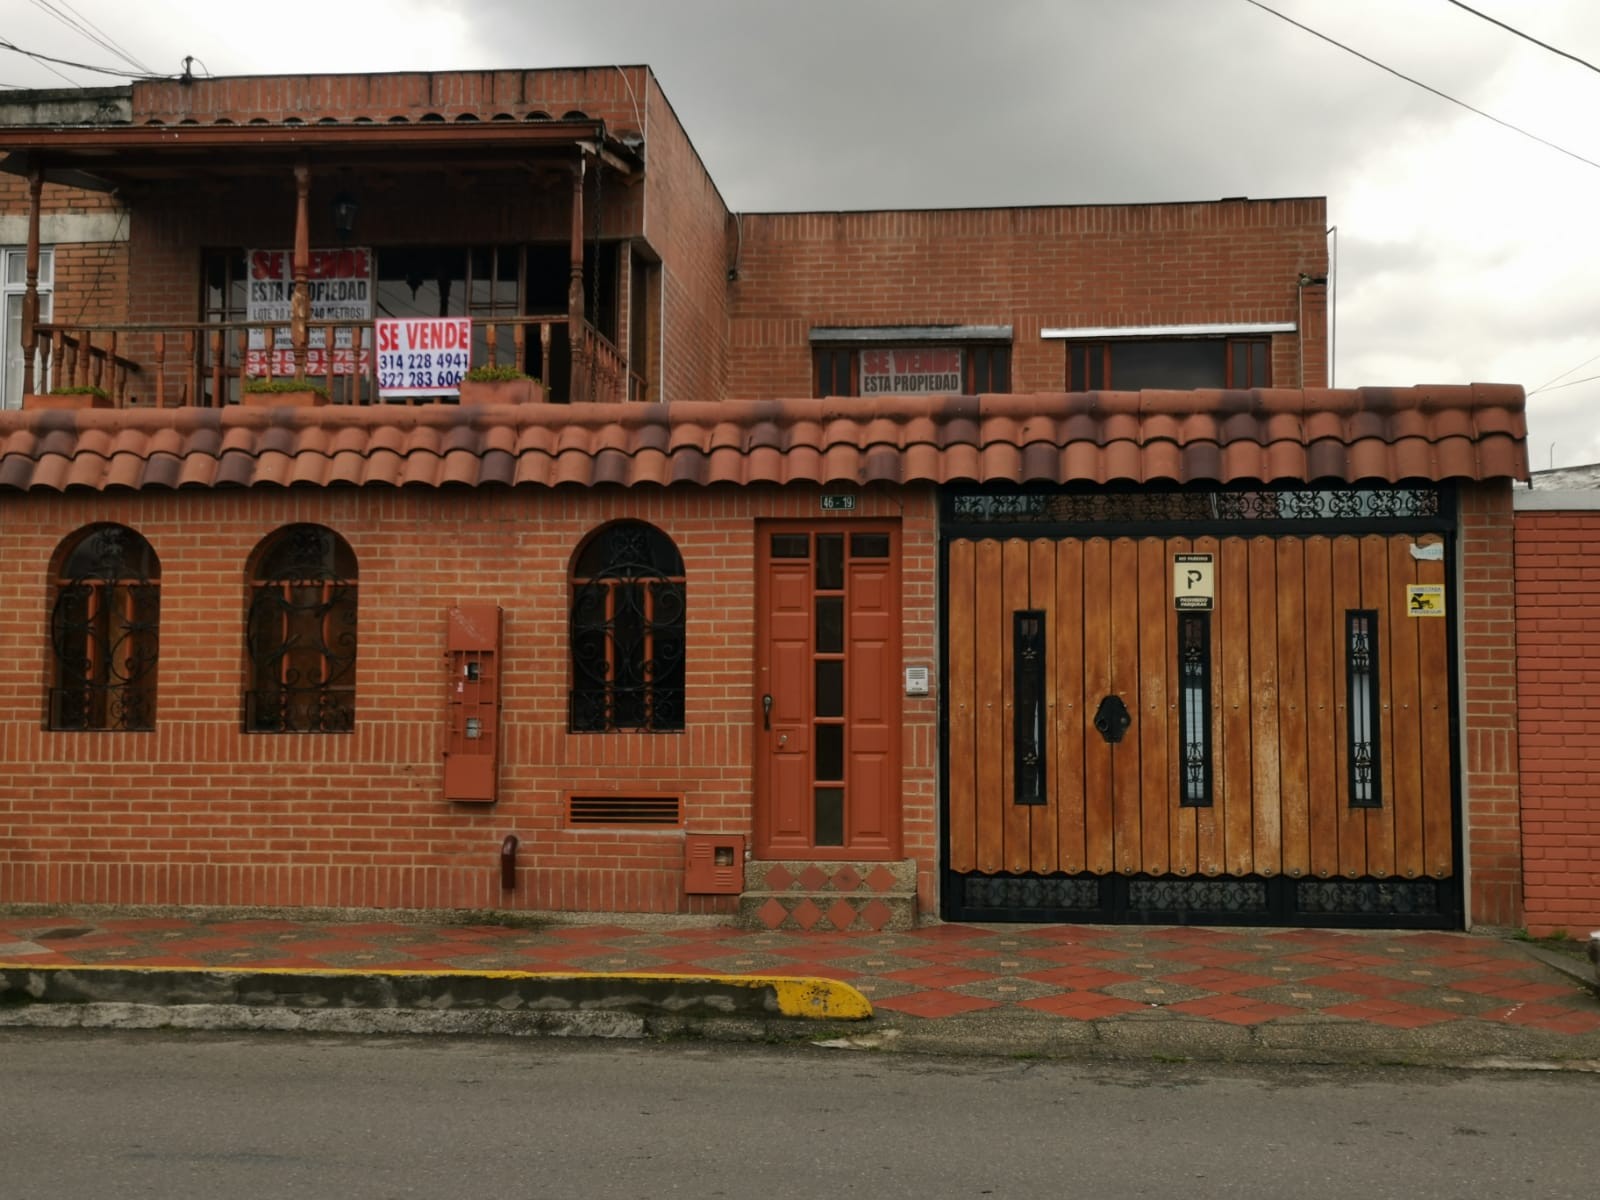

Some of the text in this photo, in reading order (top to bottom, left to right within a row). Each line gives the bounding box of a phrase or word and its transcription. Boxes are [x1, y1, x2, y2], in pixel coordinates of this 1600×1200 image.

[252, 249, 370, 280] SE ENDE
[252, 280, 367, 301] ESTA POPIEDAD
[380, 322, 468, 351] SE VENDE
[380, 353, 468, 370] 314 228 4941
[864, 351, 960, 374] SE VENDE
[380, 372, 404, 388] 322
[409, 371, 432, 387] 283
[864, 374, 958, 392] ESTA PROPIEDAD
